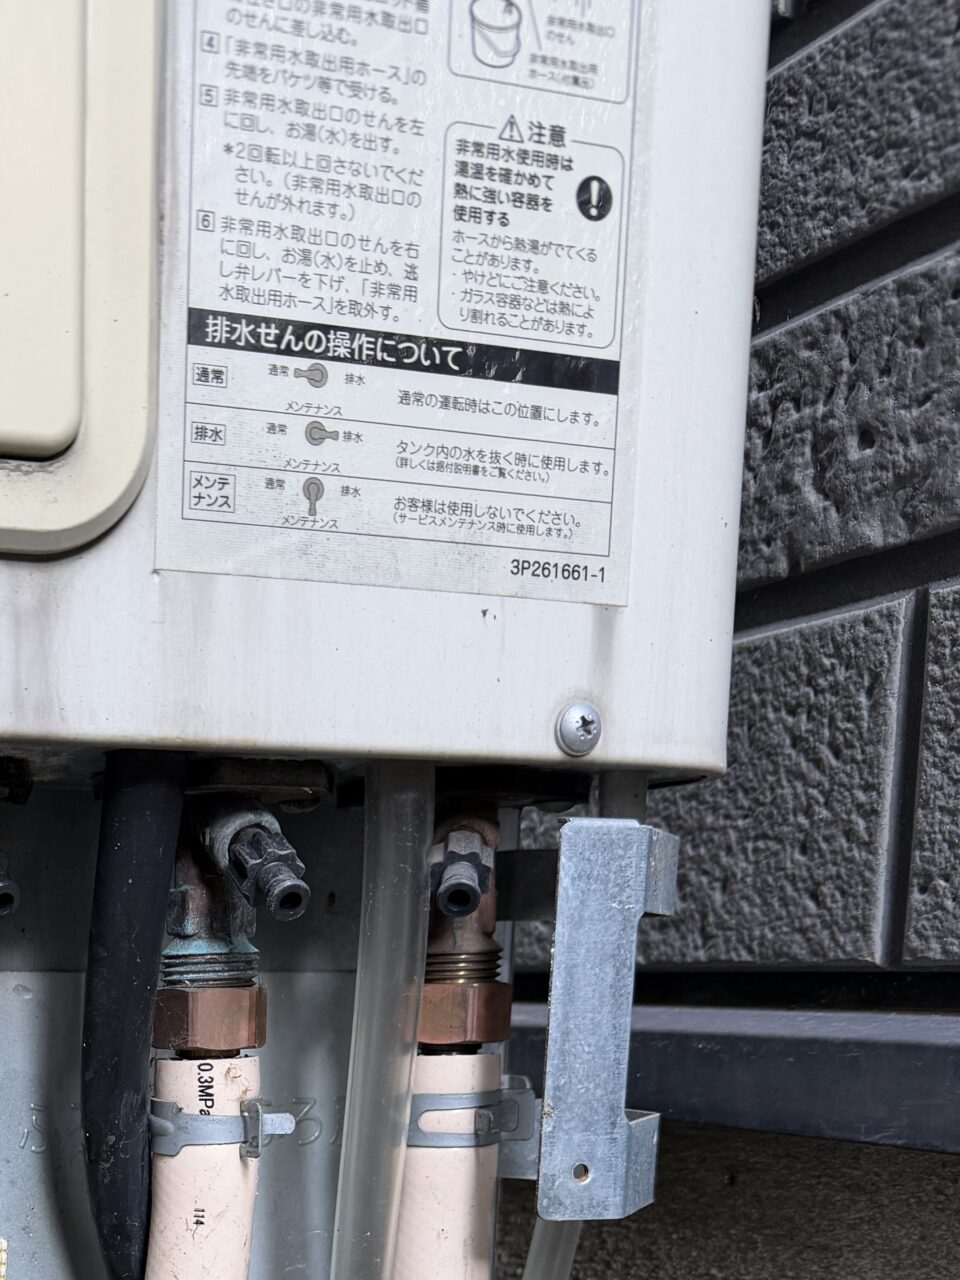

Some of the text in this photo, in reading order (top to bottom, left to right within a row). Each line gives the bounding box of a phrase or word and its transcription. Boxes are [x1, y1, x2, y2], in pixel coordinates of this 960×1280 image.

[225, 8, 358, 46] のせんに差し込む。
[225, 35, 427, 85] 「非常用水取出用ホース」の
[225, 62, 398, 105] 先端をバケツ等で受ける。
[224, 88, 425, 137] 非常用水取出口のせんを左
[528, 120, 567, 148] 注意
[456, 138, 574, 172] 非常用水使用時は
[454, 160, 555, 191] 湯温を確かめて
[453, 182, 553, 213] 熱に強い容器を
[452, 204, 510, 228] 使用する
[221, 216, 420, 260] 非常用水取出口のせんを右
[452, 230, 597, 262] ホースから熱湯がでてくる
[452, 248, 539, 274] ことがあります。
[219, 284, 399, 323] 水取出用ホース」を取外す。
[459, 308, 593, 338] り割れることがあります。
[205, 315, 464, 371] 排水せんの操作について
[196, 366, 225, 385] 通常
[267, 363, 290, 377] 通常
[344, 371, 366, 386] 排水
[285, 401, 343, 417] メンテナンス
[397, 389, 600, 427] 通常の運転時はこの位置にします。
[194, 426, 223, 443] 排水
[266, 422, 288, 435] 通常
[342, 430, 364, 443] 排水
[283, 458, 341, 473] メンテナンス
[396, 439, 609, 477] タンク内の水を抜く時に使用します。
[192, 475, 230, 491] メンテ
[264, 477, 286, 491] 通常
[340, 485, 362, 498] 排水
[192, 493, 232, 509] ナンス
[393, 496, 581, 528] お客様は使用しないでください。
[281, 515, 339, 530] メンテナンス
[510, 558, 606, 583] 3P261661-1
